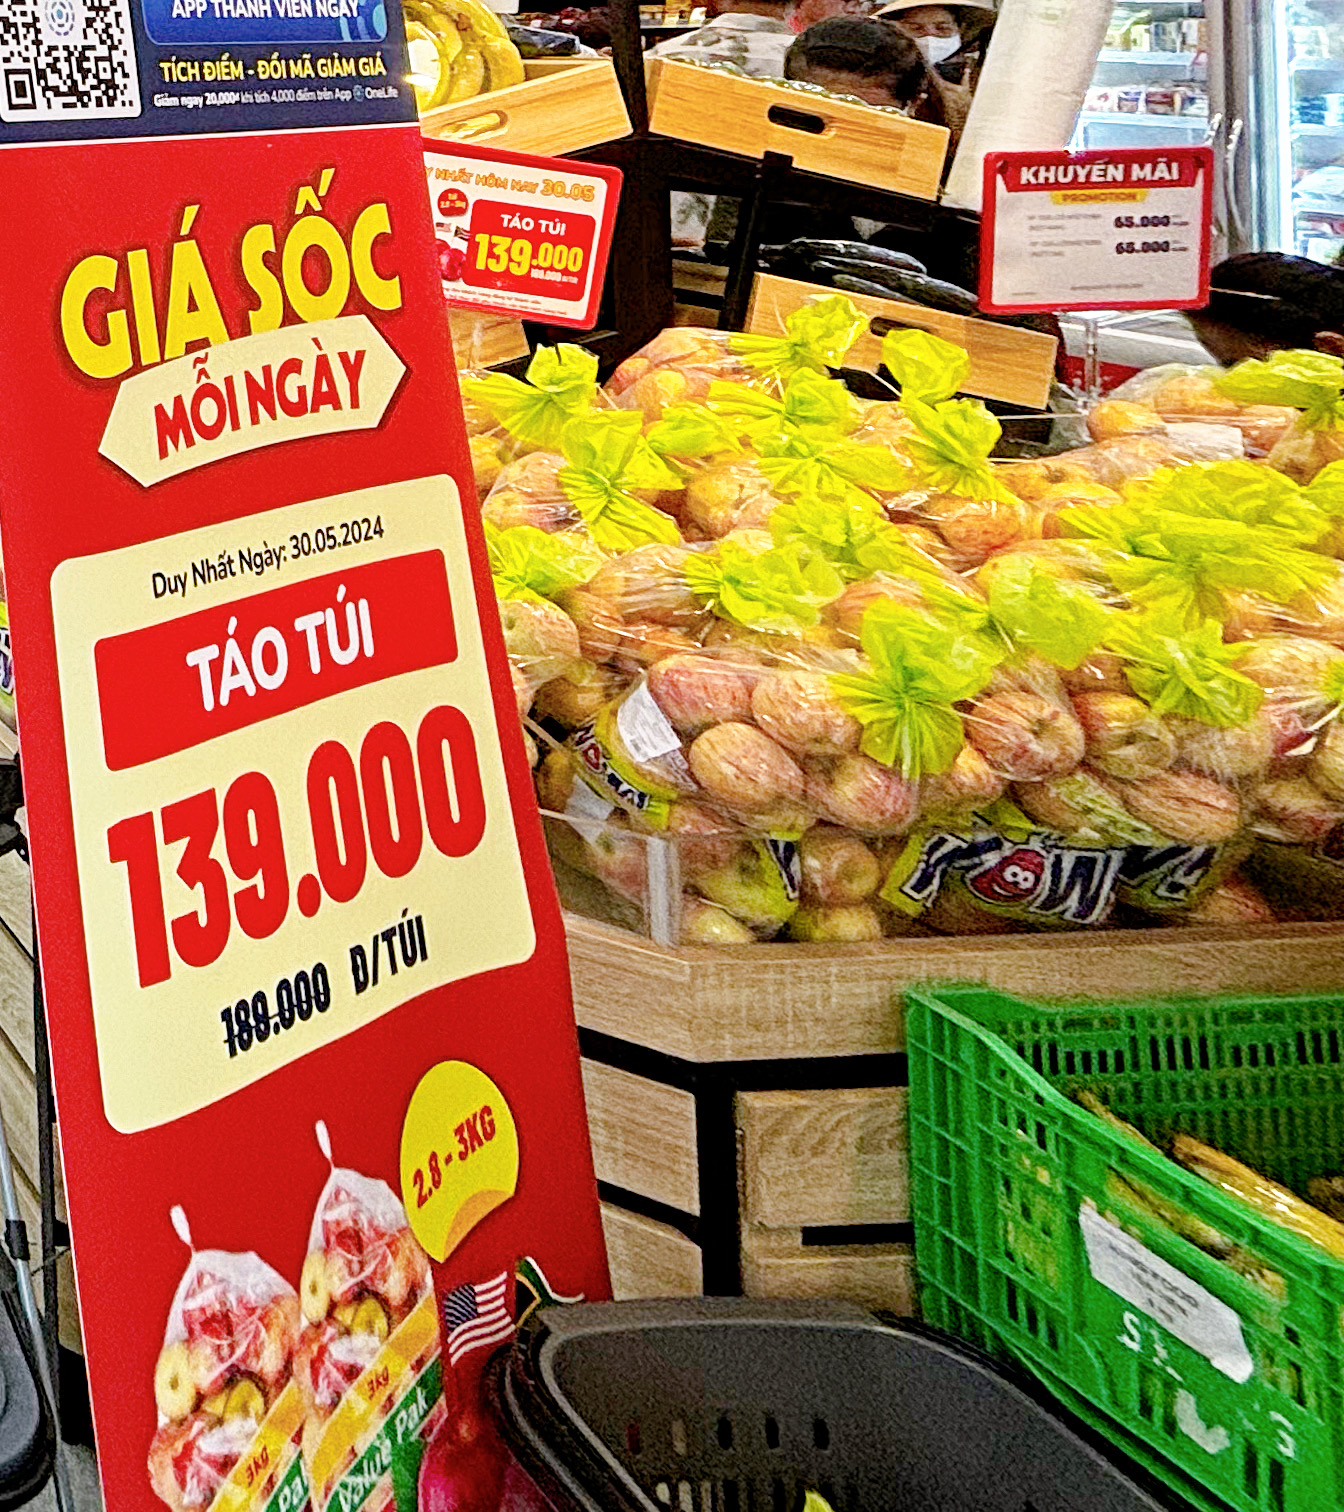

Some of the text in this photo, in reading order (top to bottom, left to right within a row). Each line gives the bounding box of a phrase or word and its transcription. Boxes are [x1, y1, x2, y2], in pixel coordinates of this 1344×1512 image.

[160, 51, 387, 82] TÍCH ĐIỂM ĐỔI MÃ GIẢM GIÁ
[154, 93, 179, 107] Giảm
[180, 95, 203, 109] ngay
[271, 89, 294, 103] 4,000
[334, 88, 353, 103] App
[365, 87, 399, 99] OneLife
[475, 173, 508, 189] HÔM
[540, 179, 595, 202] 30.05
[1020, 157, 1180, 185] KHUYẾN MÃI
[1061, 192, 1137, 203] PROMOTION
[500, 212, 567, 236] TÁO TÚI
[60, 167, 403, 379] GIÁ SỐC
[475, 233, 584, 276] 139.000
[153, 336, 367, 460] MỖI NGÀY
[152, 515, 385, 599] Duy Nhất Ngày: 30.05.2024
[186, 583, 375, 712] TÁO TÚI
[107, 705, 487, 988] 139.000
[412, 1104, 497, 1210] 2.8 3KG
[394, 1386, 430, 1444] Pak
